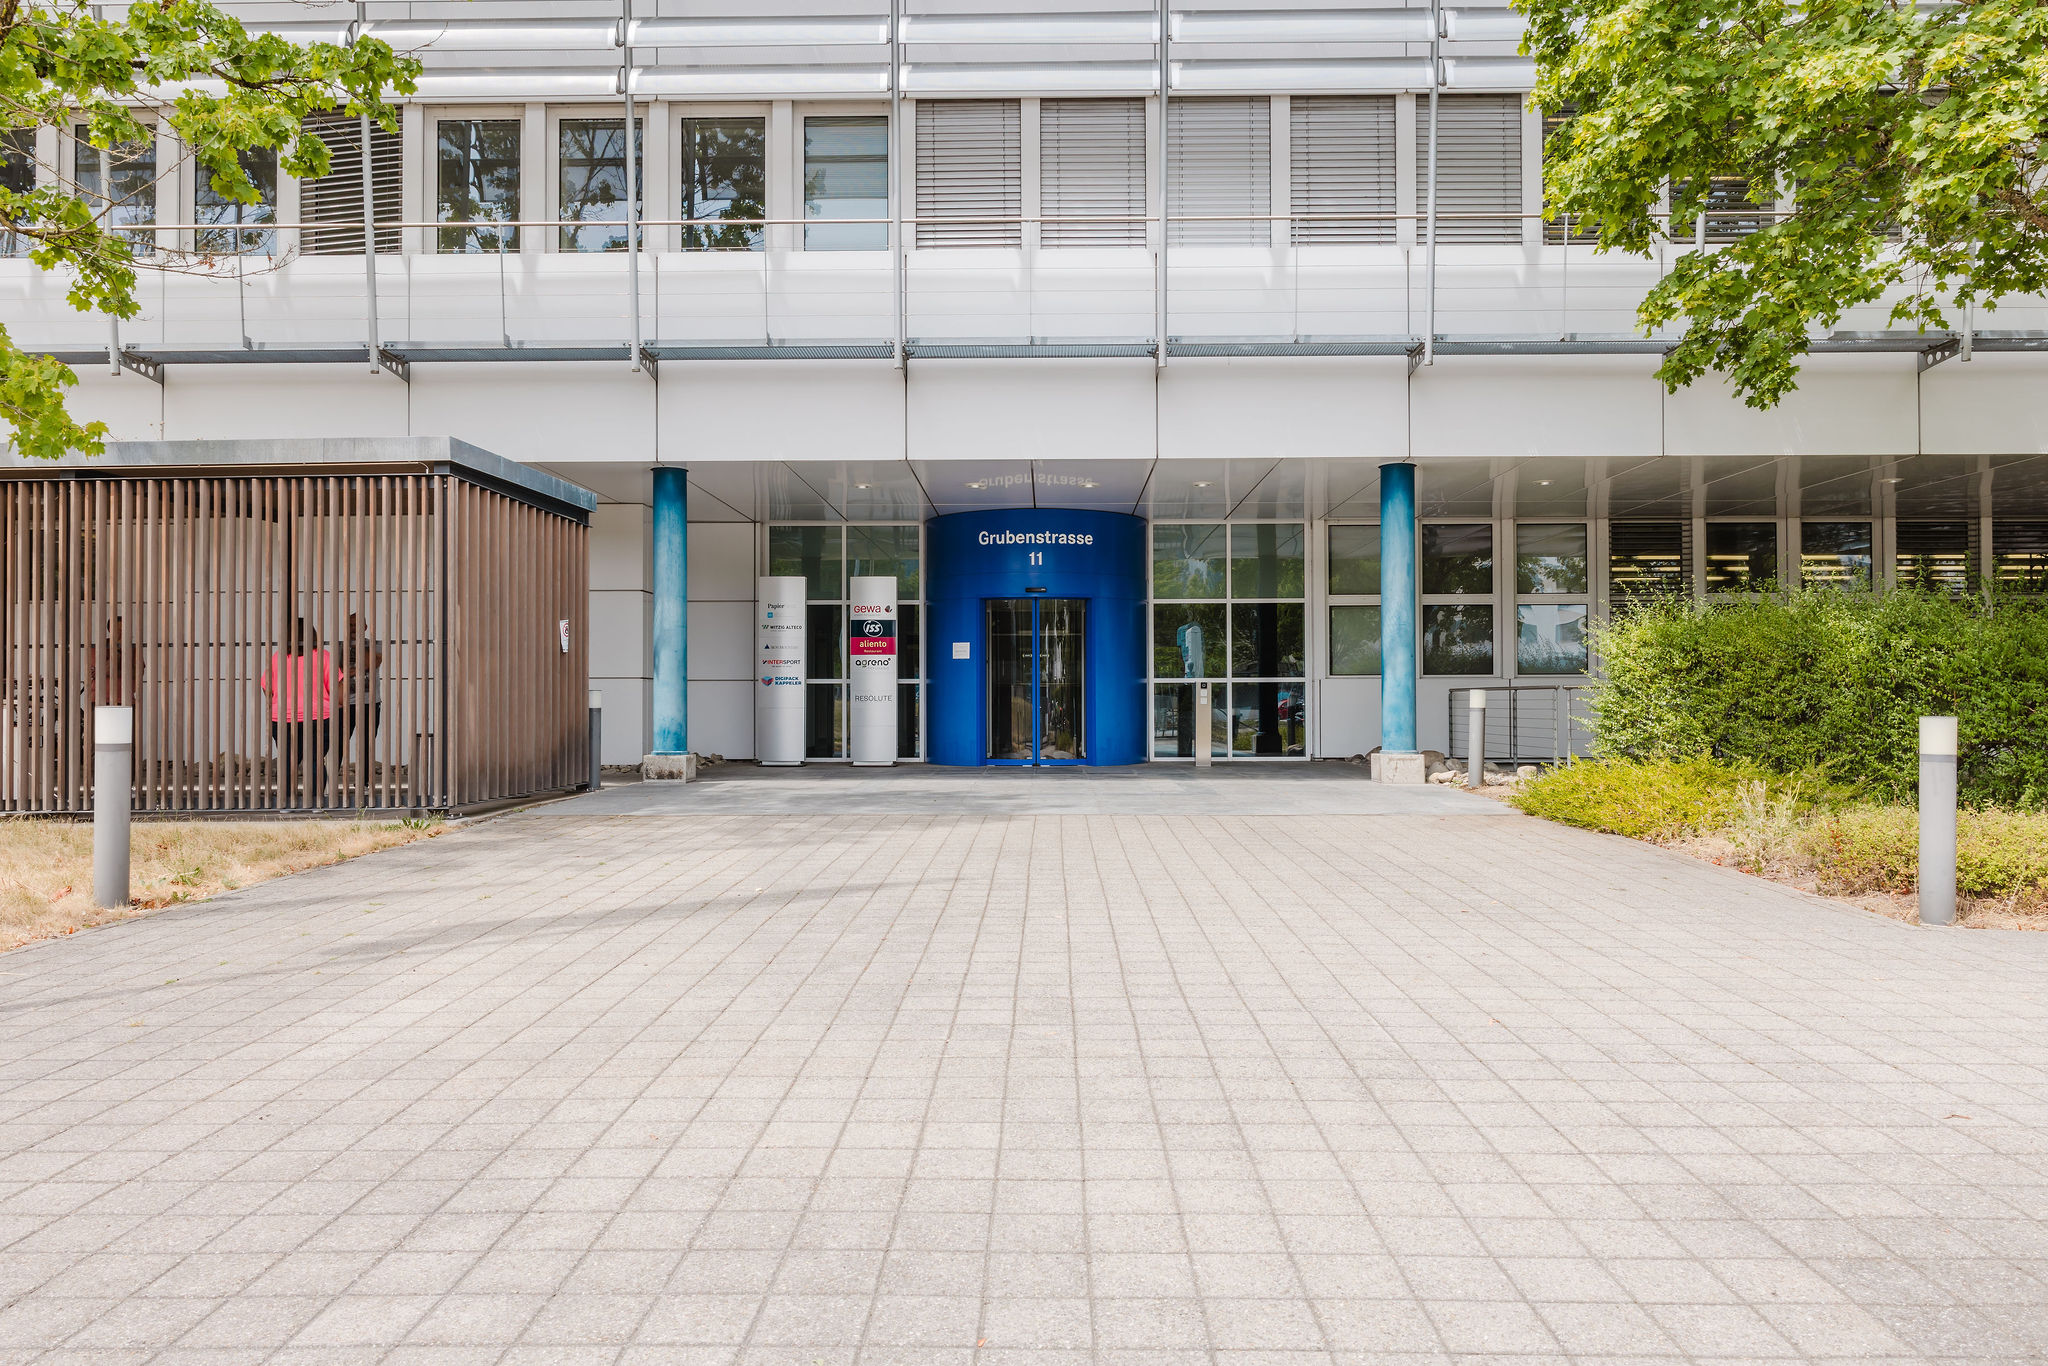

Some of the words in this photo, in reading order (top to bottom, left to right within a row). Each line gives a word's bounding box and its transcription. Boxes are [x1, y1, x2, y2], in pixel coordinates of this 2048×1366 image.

[978, 530, 1094, 545] Grubenstrasse
[1028, 551, 1043, 566] 11
[859, 640, 887, 648] aliento
